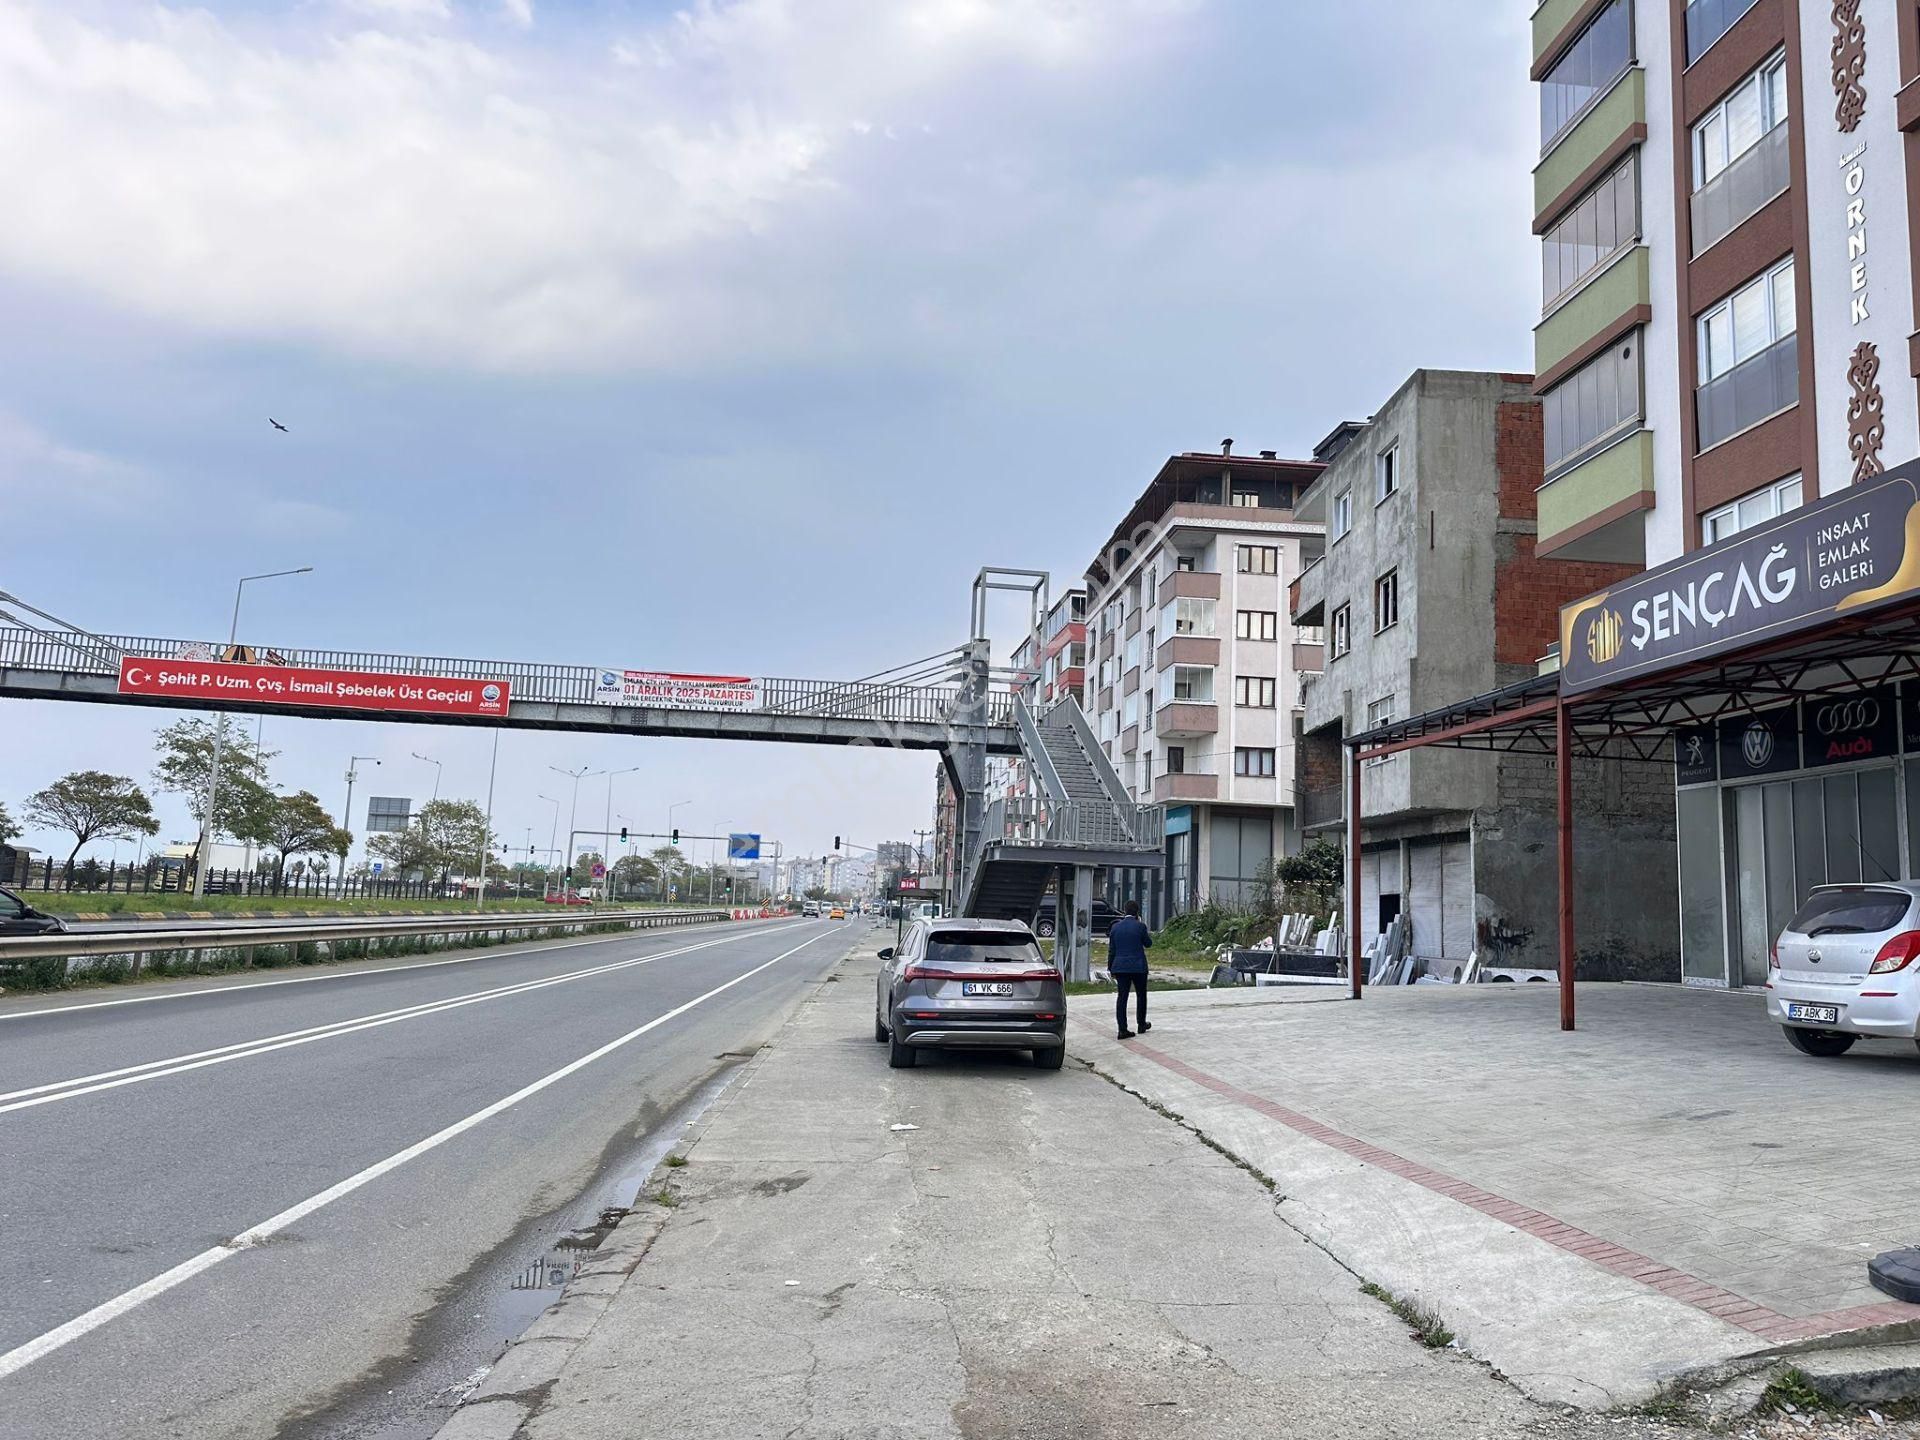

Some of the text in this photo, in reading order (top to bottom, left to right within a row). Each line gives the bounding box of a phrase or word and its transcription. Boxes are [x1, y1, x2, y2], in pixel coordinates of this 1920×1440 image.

[1845, 161, 1870, 326] ÖRNEK
[1819, 537, 1870, 567] EMLAK
[1631, 542, 1796, 650] ŞENÇAĞ
[157, 671, 473, 705] Şehit P. Uzm. Çvş. İsmail Şebelek Üst Geçidi
[624, 684, 755, 701] 01 ARALIK 2025 PAZARTESİ
[1681, 767, 1712, 777] PEUGEOT
[900, 879, 917, 889] BİM
[968, 984, 1012, 993] 61 VK 666
[1792, 1006, 1834, 1020] 55 ABK 38
